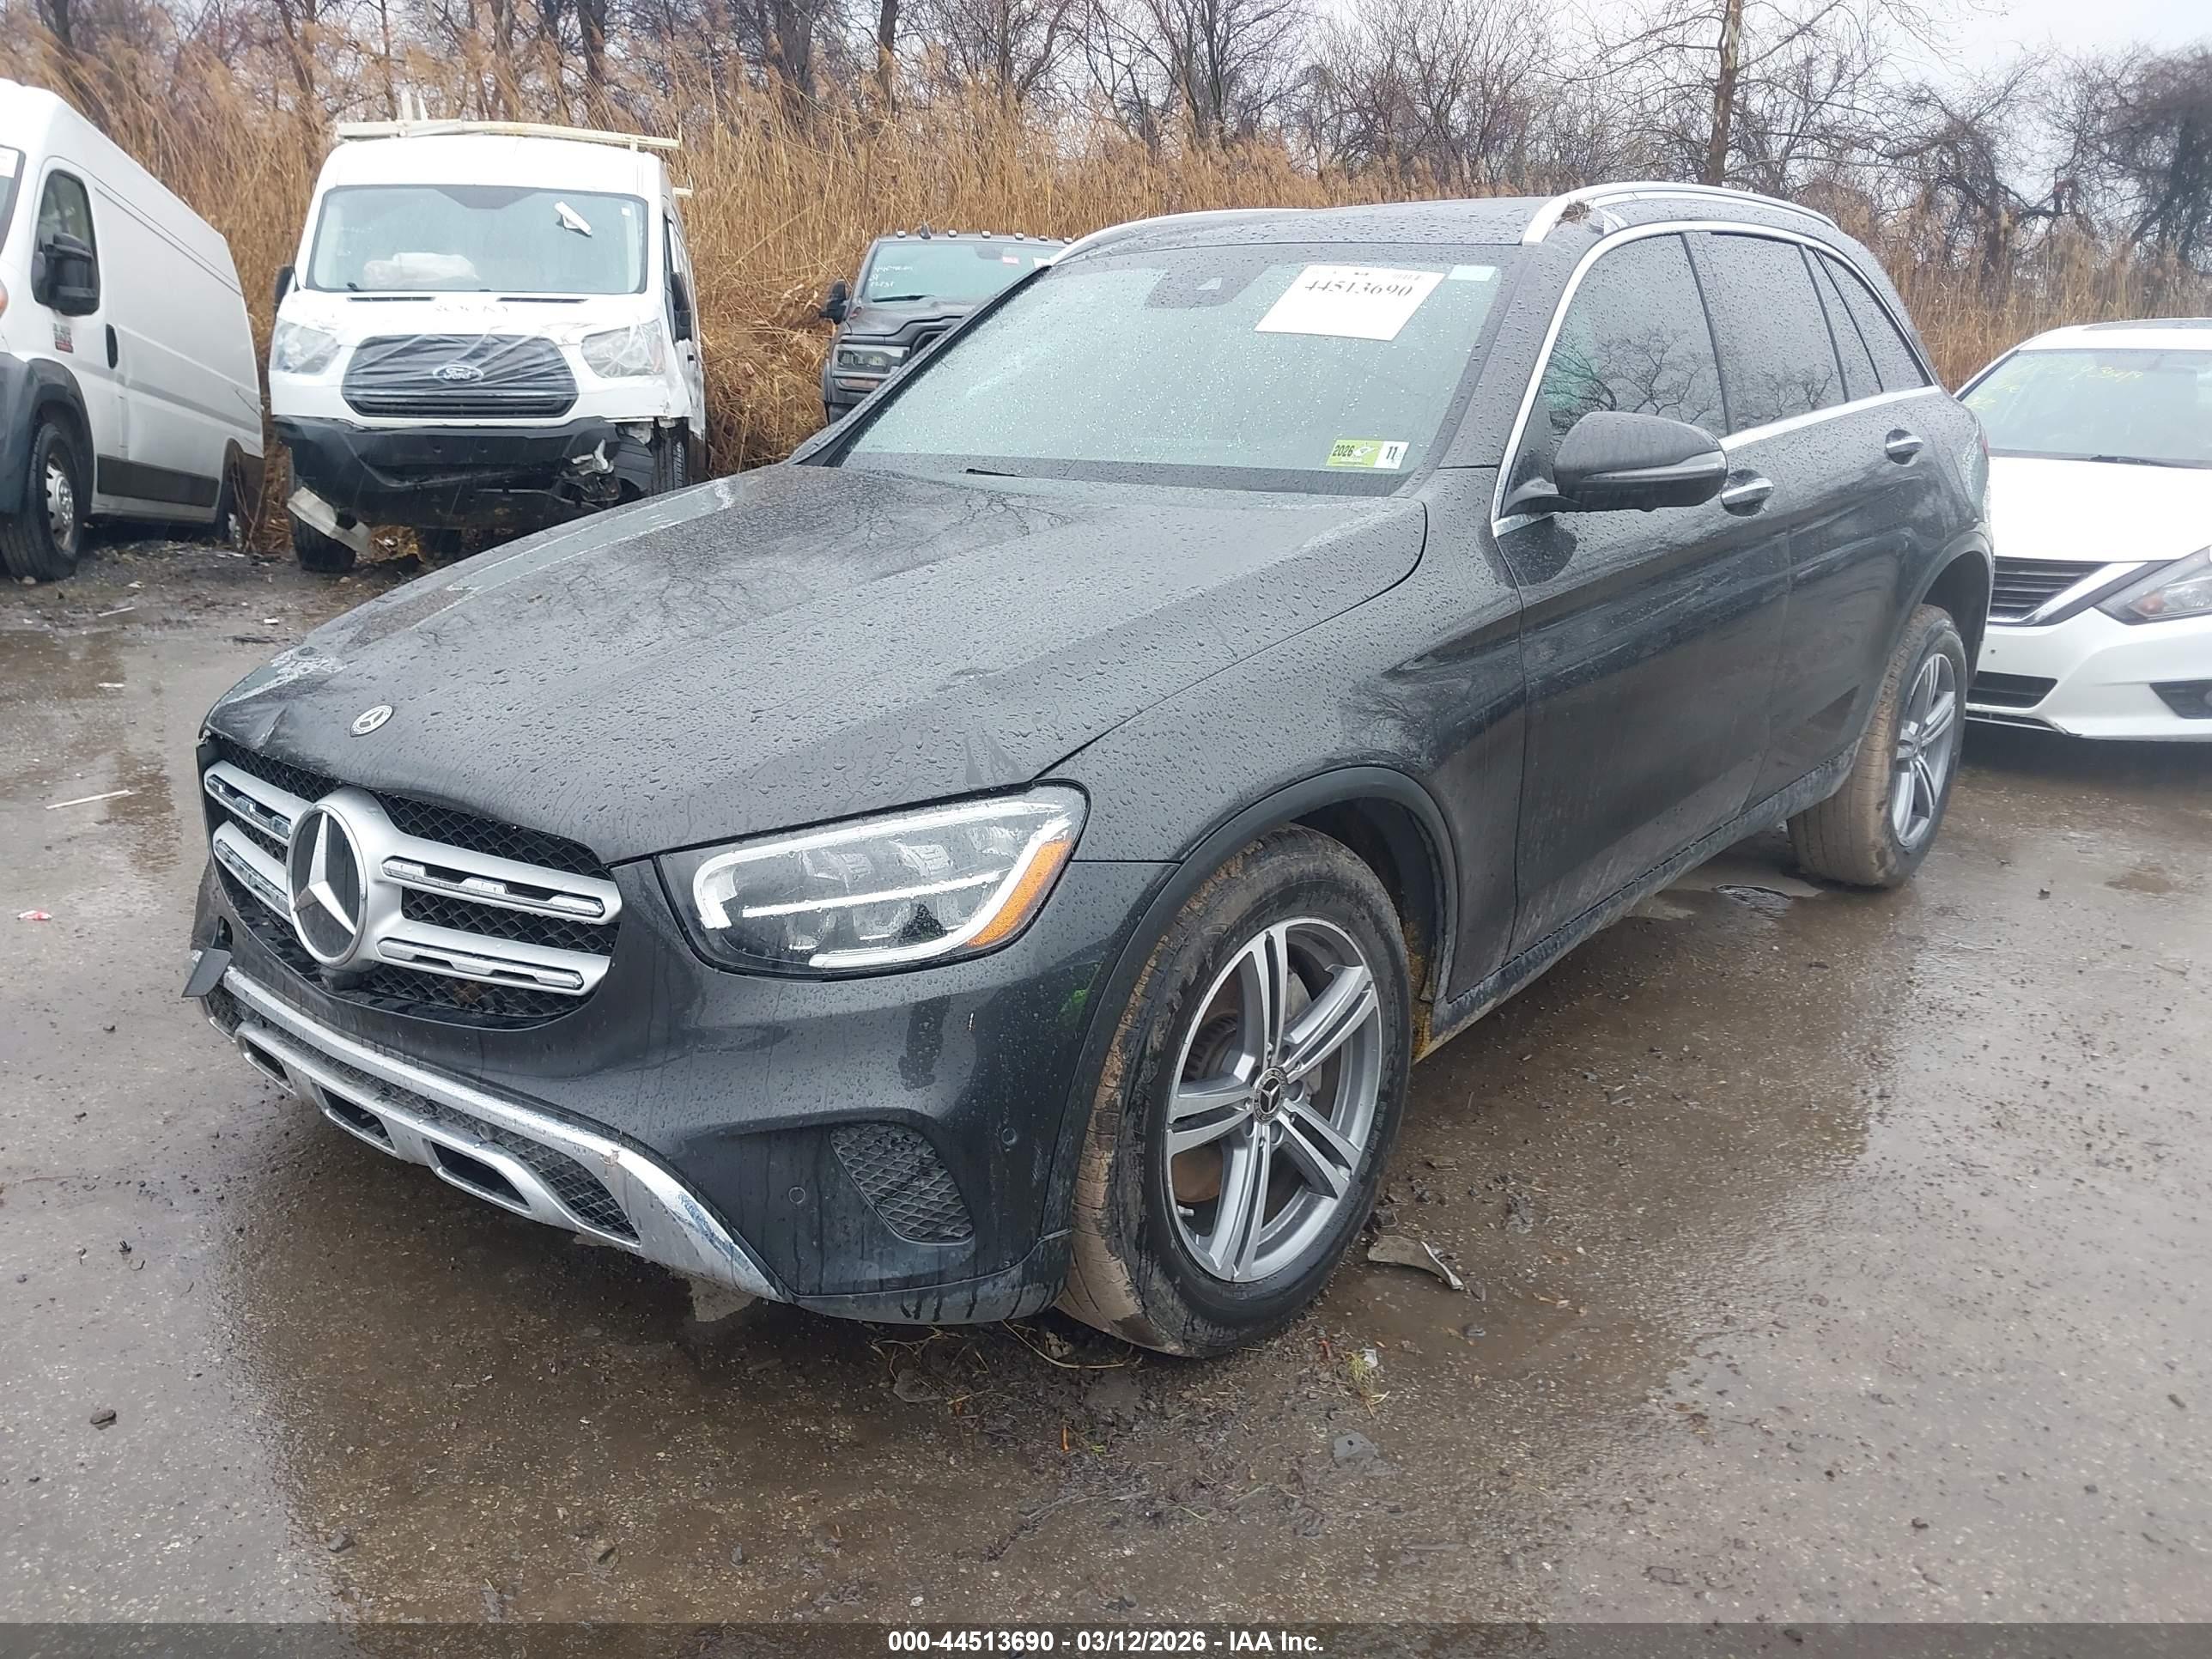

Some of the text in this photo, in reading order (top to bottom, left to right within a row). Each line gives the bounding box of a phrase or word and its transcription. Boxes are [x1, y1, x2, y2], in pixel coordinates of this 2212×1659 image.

[1304, 279, 1415, 298] 44513690
[1332, 444, 1356, 457] 2026
[1385, 446, 1400, 460] 11
